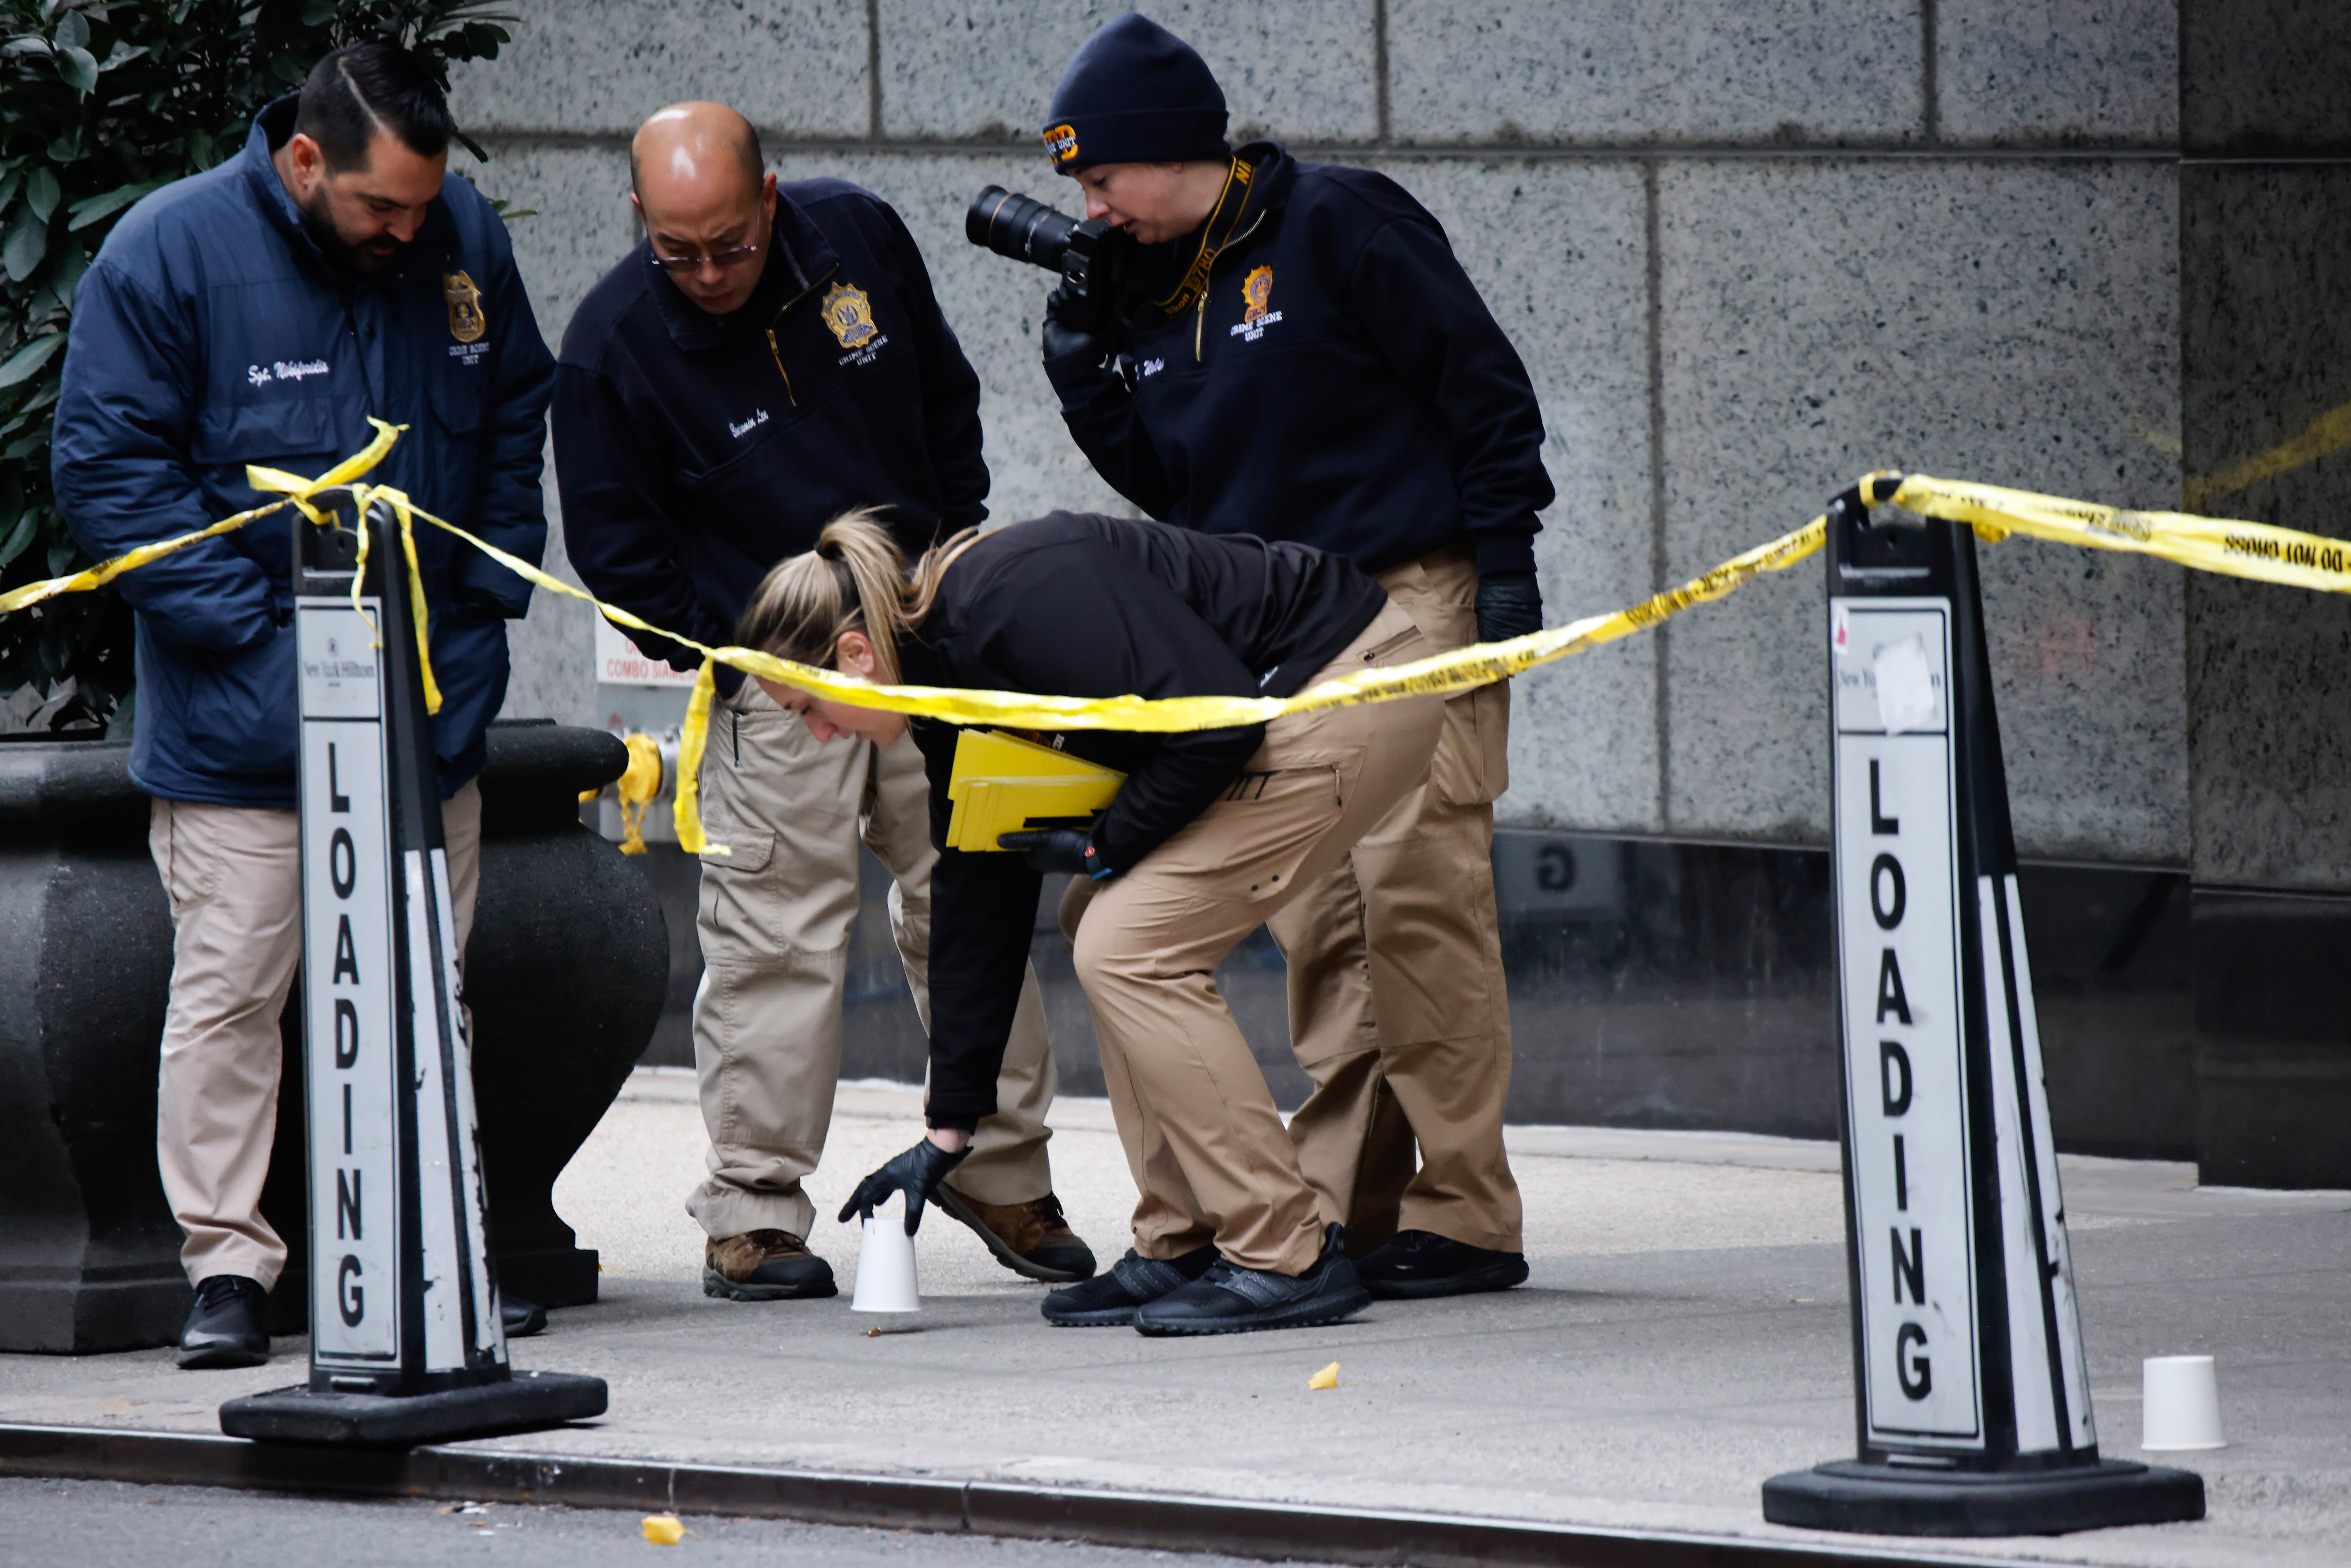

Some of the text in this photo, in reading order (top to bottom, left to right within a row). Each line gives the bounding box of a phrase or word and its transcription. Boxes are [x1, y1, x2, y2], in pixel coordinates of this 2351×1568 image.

[1256, 310, 1283, 328] SCENE
[1245, 326, 1264, 342] UNIT
[607, 659, 648, 678] COMBO
[328, 741, 364, 1328] LOADING
[1870, 759, 1932, 1402] LOADING
